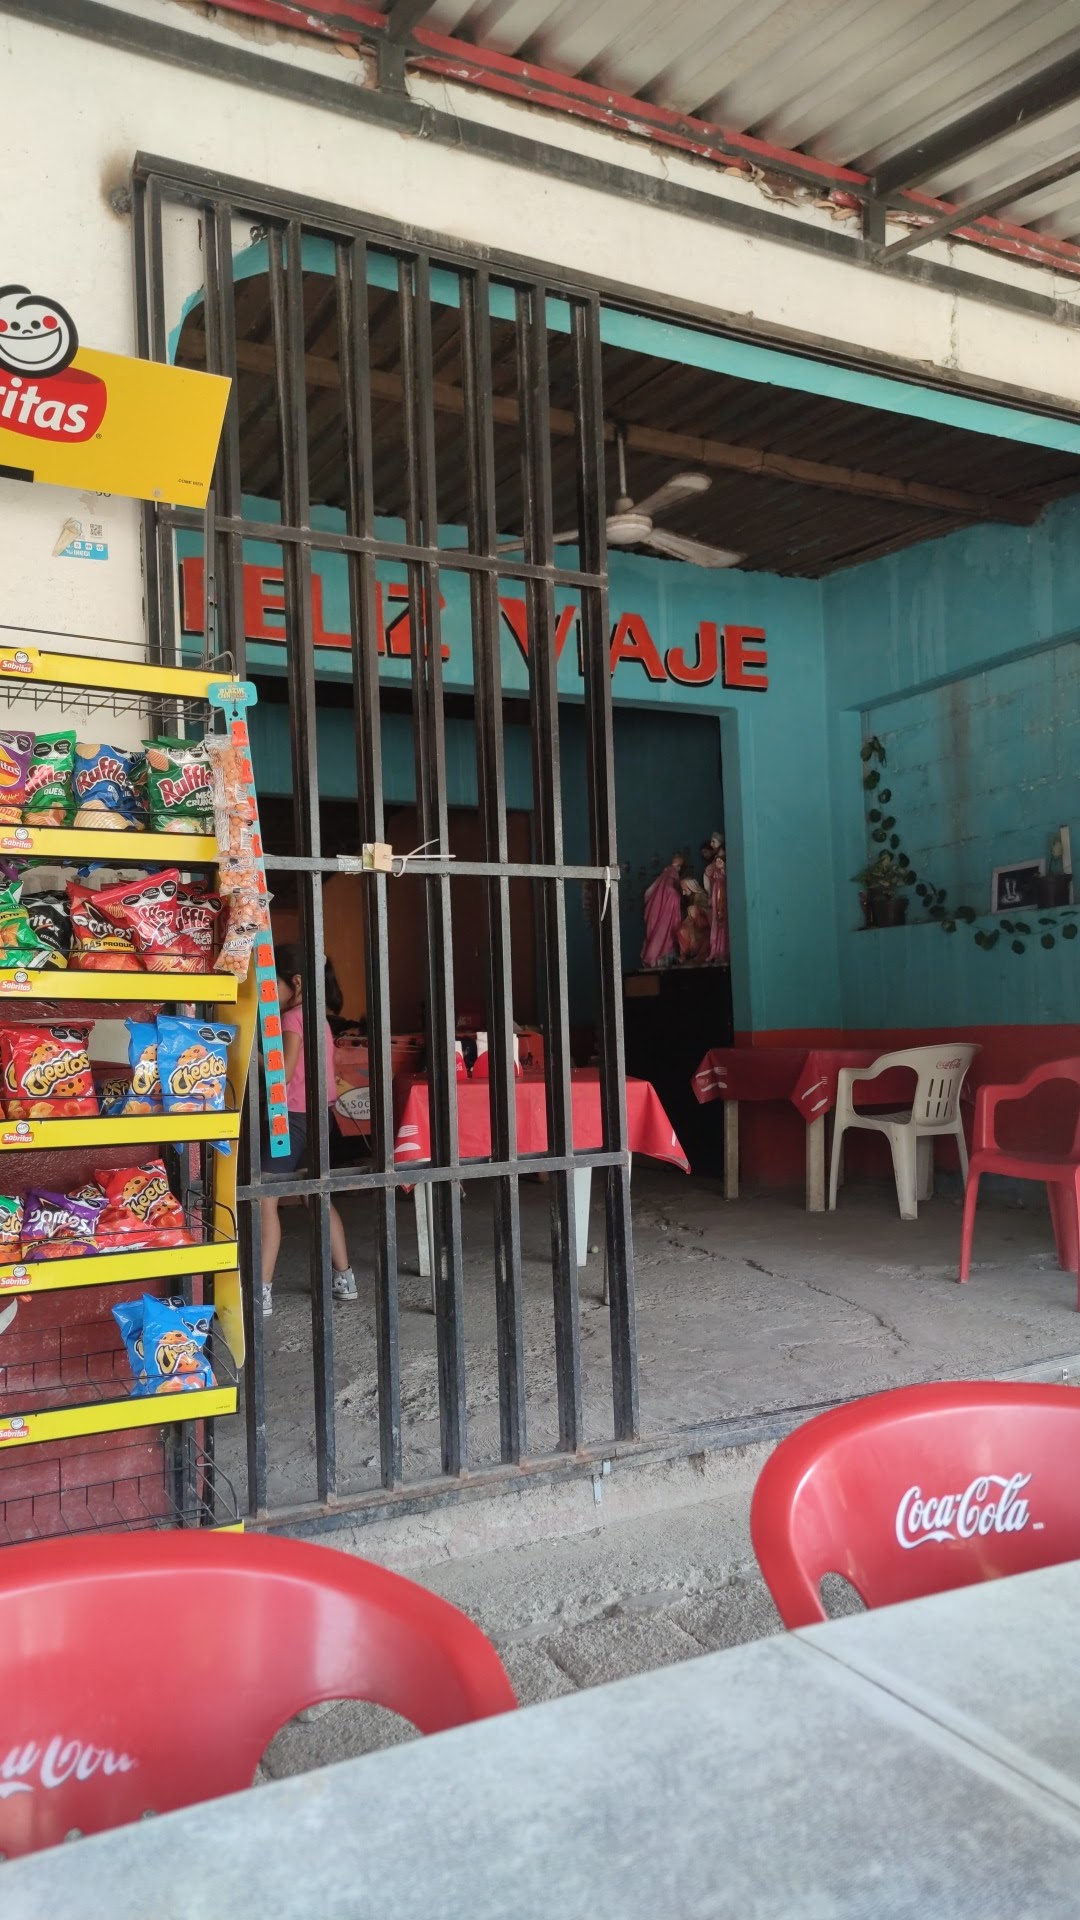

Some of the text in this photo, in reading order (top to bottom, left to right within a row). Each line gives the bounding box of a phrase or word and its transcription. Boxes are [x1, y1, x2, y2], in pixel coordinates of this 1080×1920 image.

[0, 377, 89, 434] itas
[498, 597, 769, 692] VAJE
[2, 660, 32, 673] Sabritas
[0, 761, 20, 777] itas
[76, 756, 126, 796] Ruffle
[157, 764, 213, 807] Ruffle
[185, 799, 215, 808] CRUNC
[3, 836, 32, 849] Sabritas
[1, 979, 31, 991] Sabritas
[22, 1049, 91, 1097] Cheetos
[170, 1053, 227, 1097] Cheetos
[4, 1132, 33, 1143] Sabritas
[126, 1177, 169, 1222] heeto
[1, 1276, 31, 1287] Sabritas
[895, 1473, 1033, 1549] Coca-Cola
